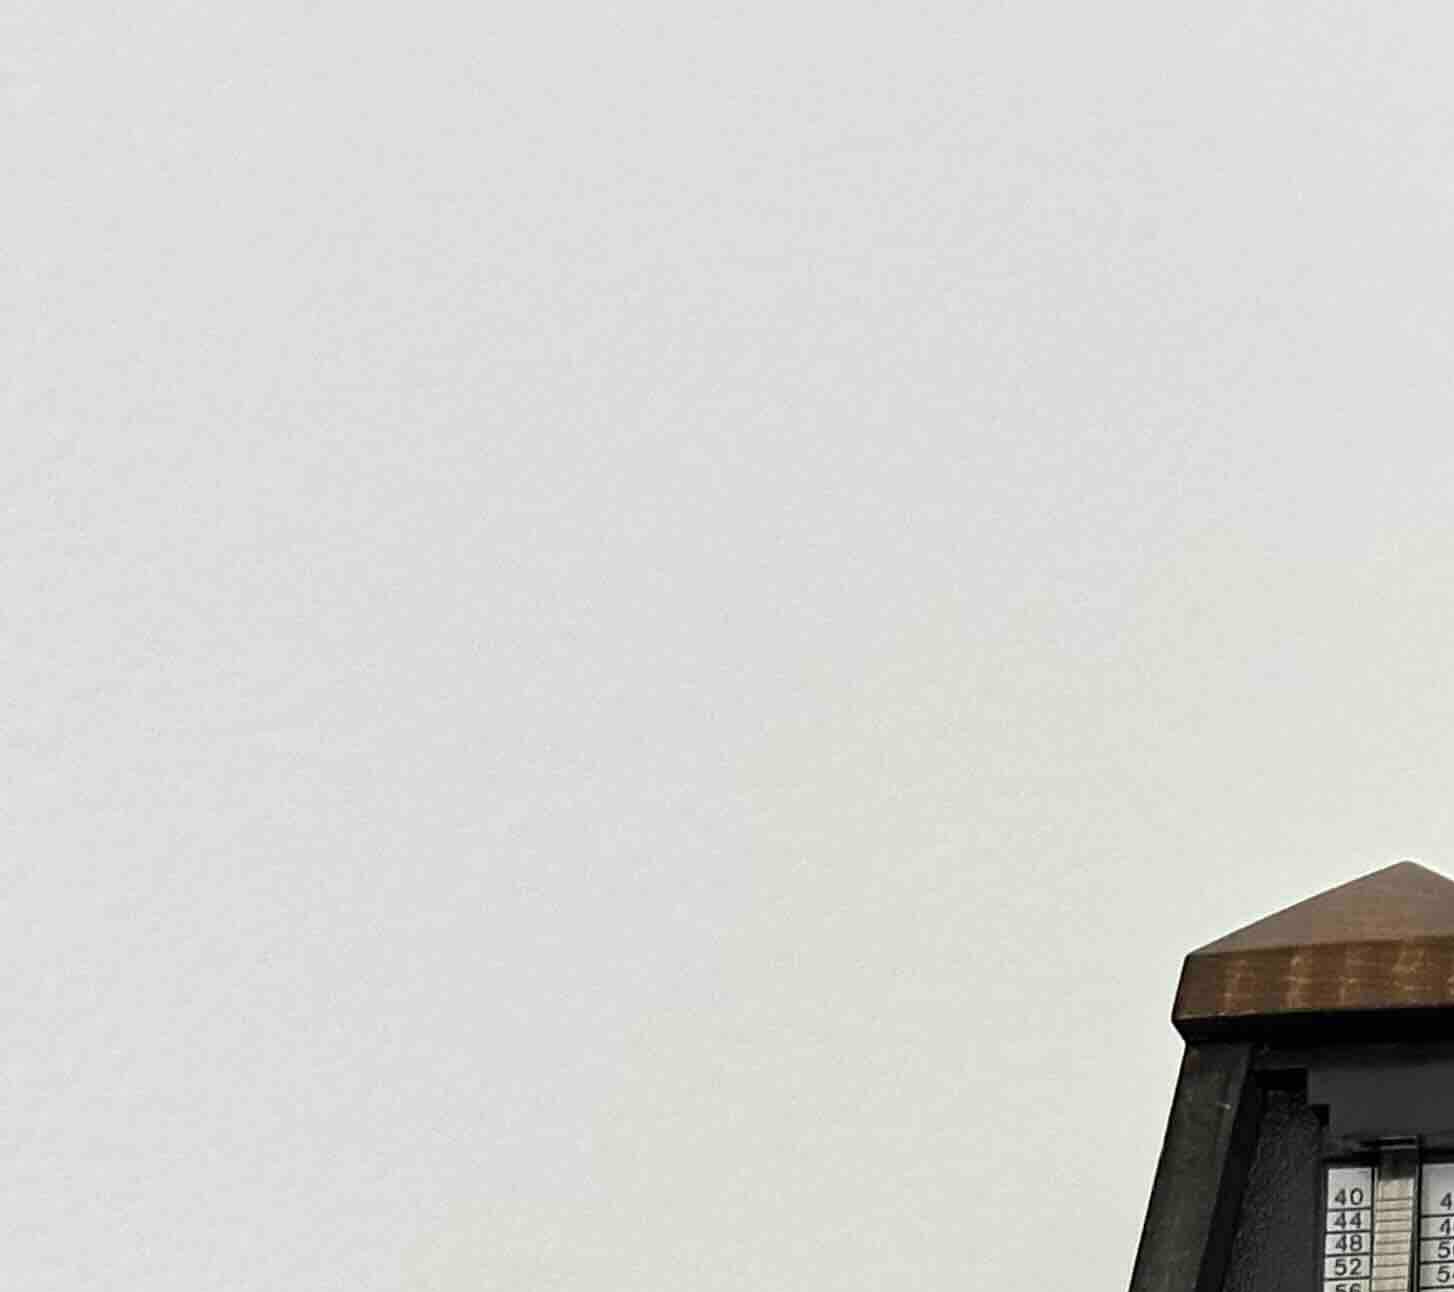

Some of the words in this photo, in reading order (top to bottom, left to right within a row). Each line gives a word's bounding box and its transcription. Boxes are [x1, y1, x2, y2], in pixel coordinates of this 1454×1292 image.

[1334, 1188, 1362, 1205] 40
[1334, 1213, 1361, 1229] 44
[1334, 1235, 1362, 1251] 48
[1334, 1258, 1361, 1276] 52
